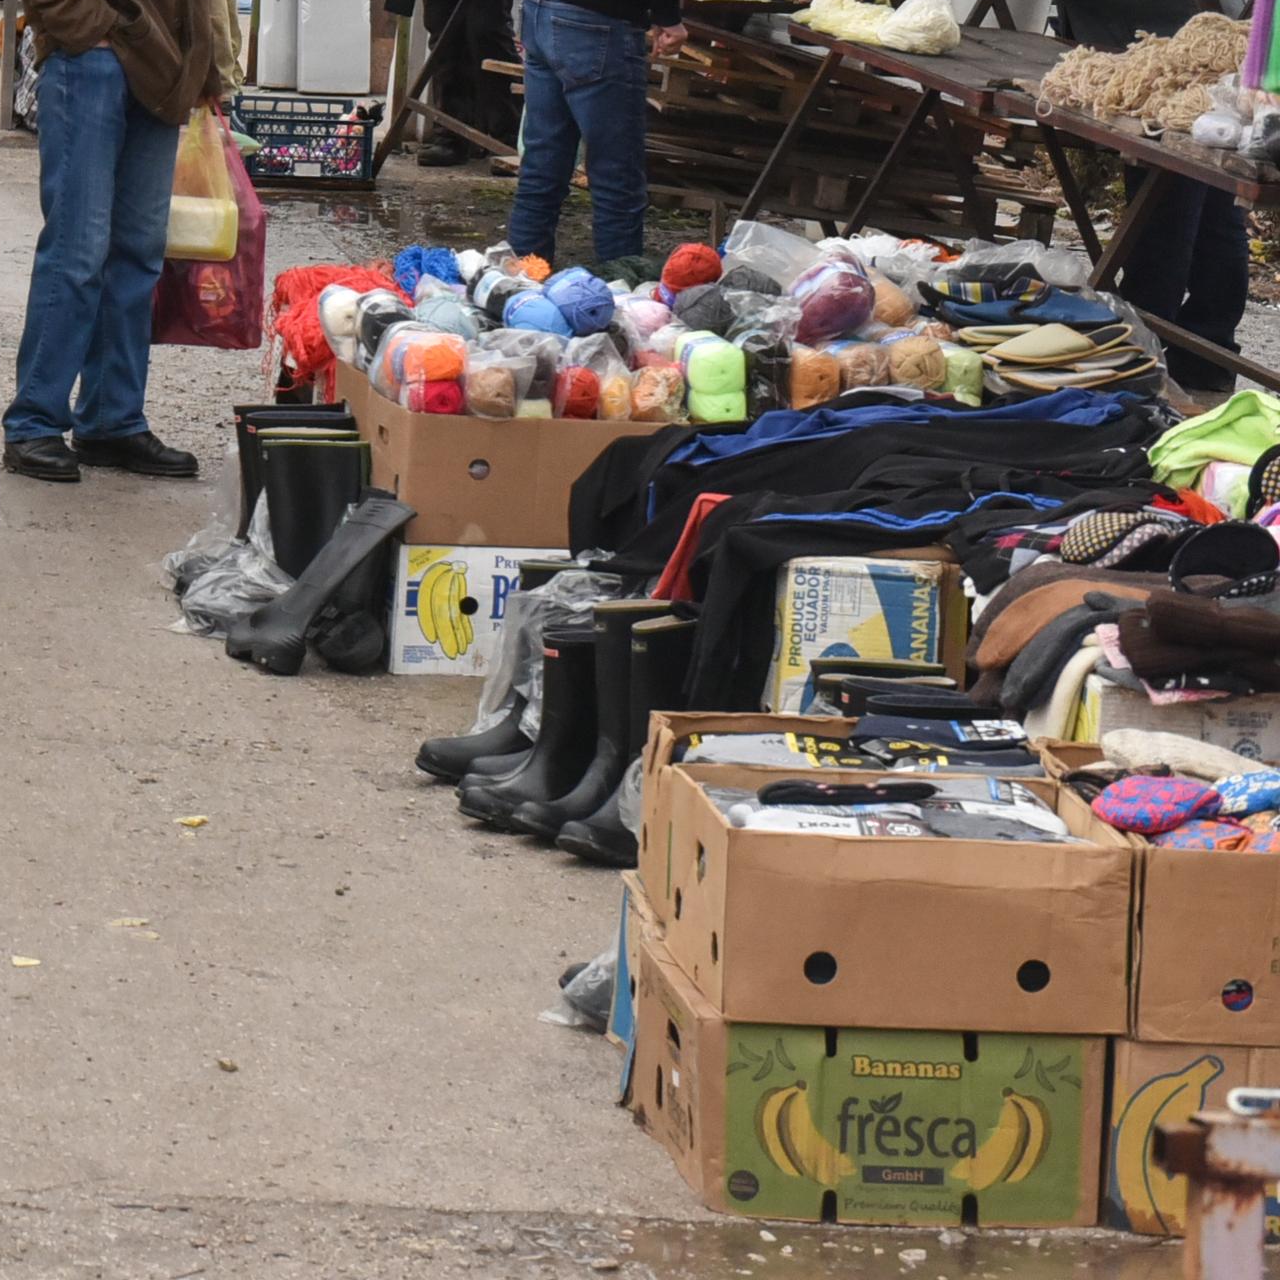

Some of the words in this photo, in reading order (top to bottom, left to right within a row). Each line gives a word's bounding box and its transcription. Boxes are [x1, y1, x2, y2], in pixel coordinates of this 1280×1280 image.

[795, 565, 807, 586] OF
[804, 566, 821, 642] ECUADOR
[819, 594, 831, 634] VACUUM
[788, 590, 805, 667] PRODUCE
[852, 1054, 962, 1079] Bananas
[837, 1096, 977, 1159] fresca
[881, 1170, 925, 1183] GmbH
[843, 1198, 905, 1211] Premium
[908, 1200, 962, 1215] Quality
